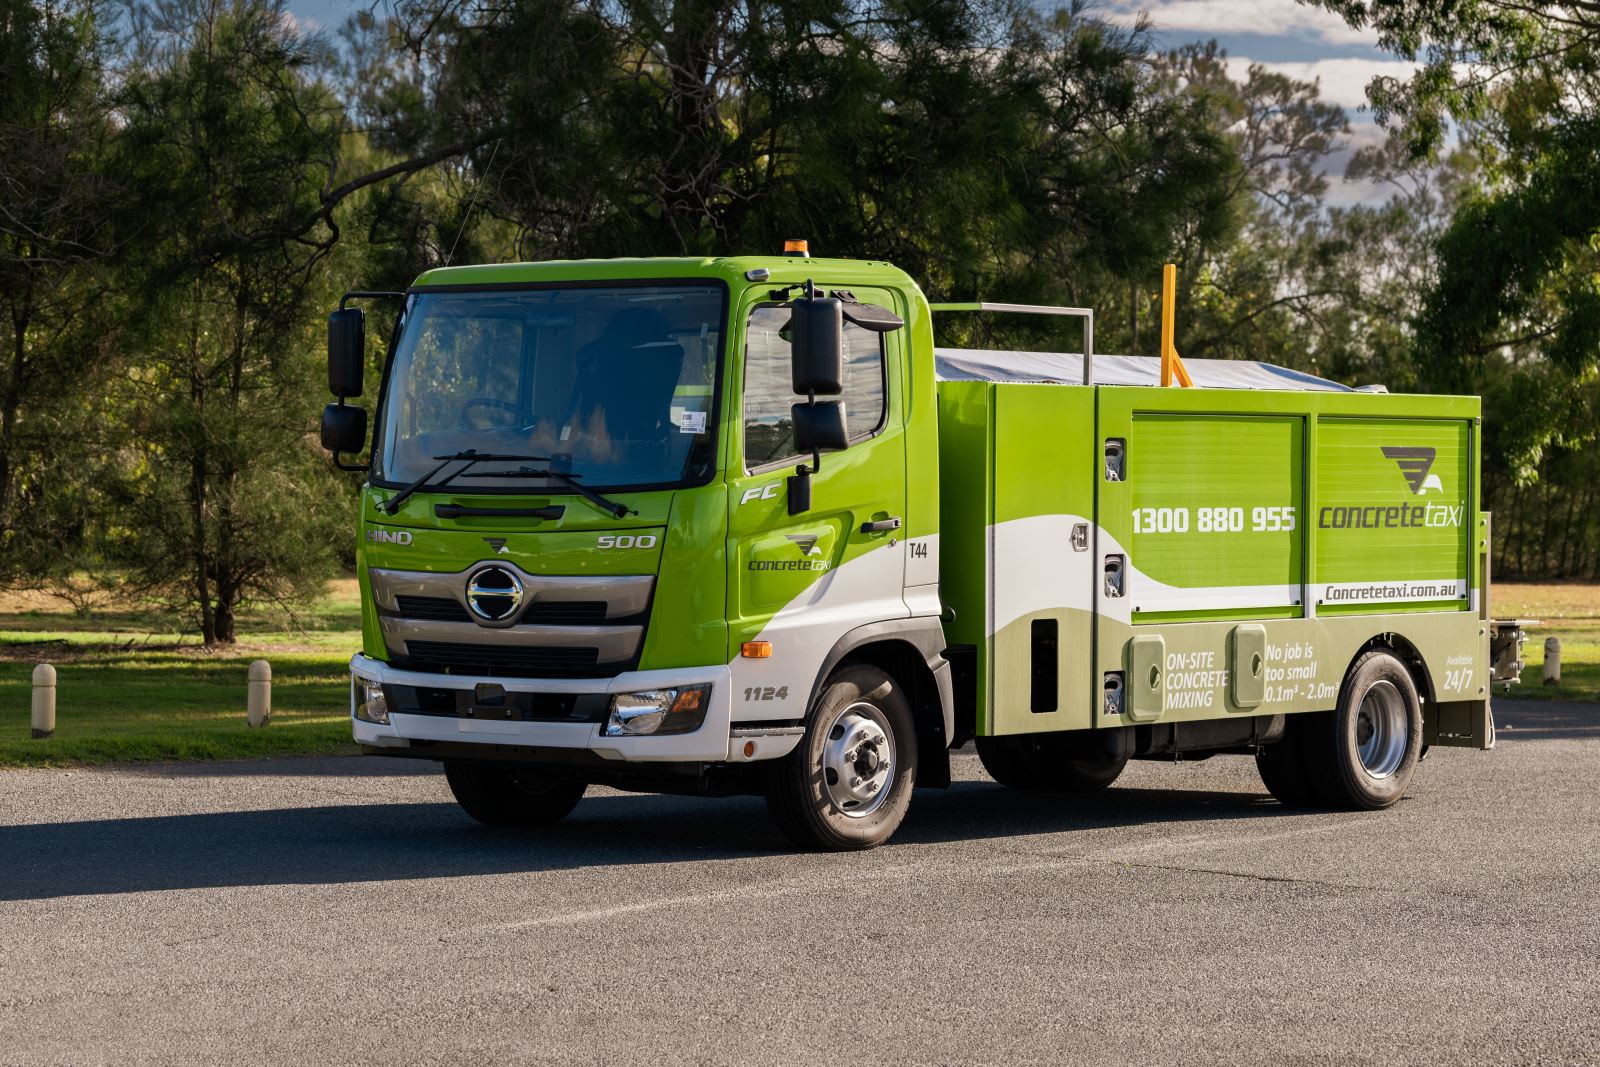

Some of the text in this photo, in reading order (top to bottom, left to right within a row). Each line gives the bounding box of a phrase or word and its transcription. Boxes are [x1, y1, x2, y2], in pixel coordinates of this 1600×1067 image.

[740, 481, 782, 505] FC
[1132, 506, 1296, 534] 1300 880 955
[367, 529, 413, 546] HINO
[597, 535, 657, 549] 500
[909, 543, 928, 559] T44
[1325, 583, 1457, 602] Concretetaxi.com.au
[1166, 651, 1215, 671] ON-SITE
[1265, 642, 1313, 663] No job is
[1446, 655, 1473, 665] Available
[1166, 670, 1229, 690] CONCRETE
[1265, 662, 1317, 681] too small
[1443, 667, 1473, 693] 24/7
[743, 686, 789, 701] 1124
[1166, 690, 1214, 709] MIXING
